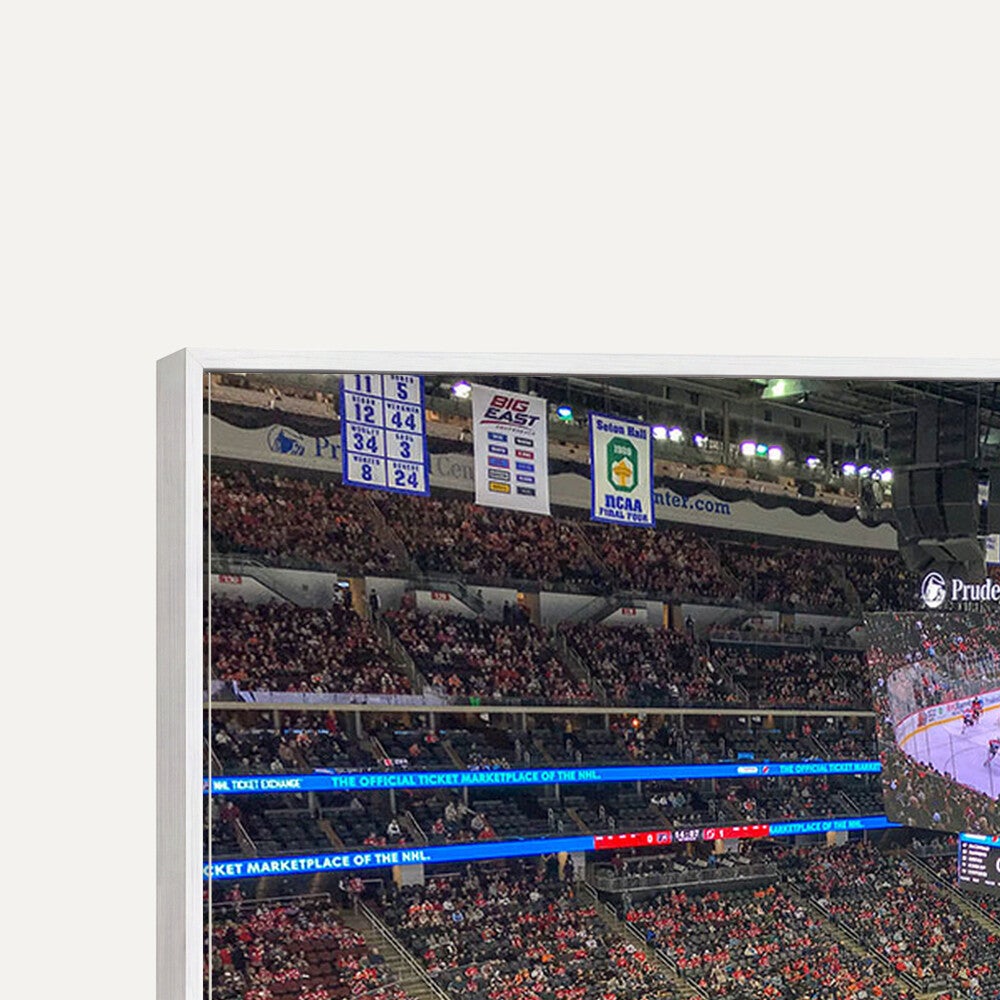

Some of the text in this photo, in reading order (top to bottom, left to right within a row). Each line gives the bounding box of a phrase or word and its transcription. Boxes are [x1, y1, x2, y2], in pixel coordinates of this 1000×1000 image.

[354, 374, 371, 393] 11
[397, 382, 408, 400] 5
[490, 395, 530, 412] BIG
[354, 403, 375, 423] 12
[392, 411, 416, 430] 44
[484, 407, 540, 427] EAST
[596, 419, 647, 440] Seton Hall
[353, 432, 378, 453] 34
[400, 441, 411, 458] 3
[361, 464, 372, 481] 8
[394, 470, 418, 488] 24
[605, 494, 642, 512] NCAA
[599, 507, 625, 519] FINAL
[780, 765, 794, 773] THE
[795, 764, 828, 773] OFFICIAL
[829, 763, 853, 772] TICKET
[331, 776, 356, 788] THE
[359, 774, 415, 787] OFFICIAL
[418, 773, 458, 785] TICKET
[461, 771, 538, 784] MARKETPLACE
[541, 771, 555, 781] OF
[557, 770, 576, 780] THE
[247, 857, 349, 873] MARKETPLACE
[353, 854, 371, 865] OF
[374, 852, 398, 864] THE
[401, 851, 431, 862] NHL.
